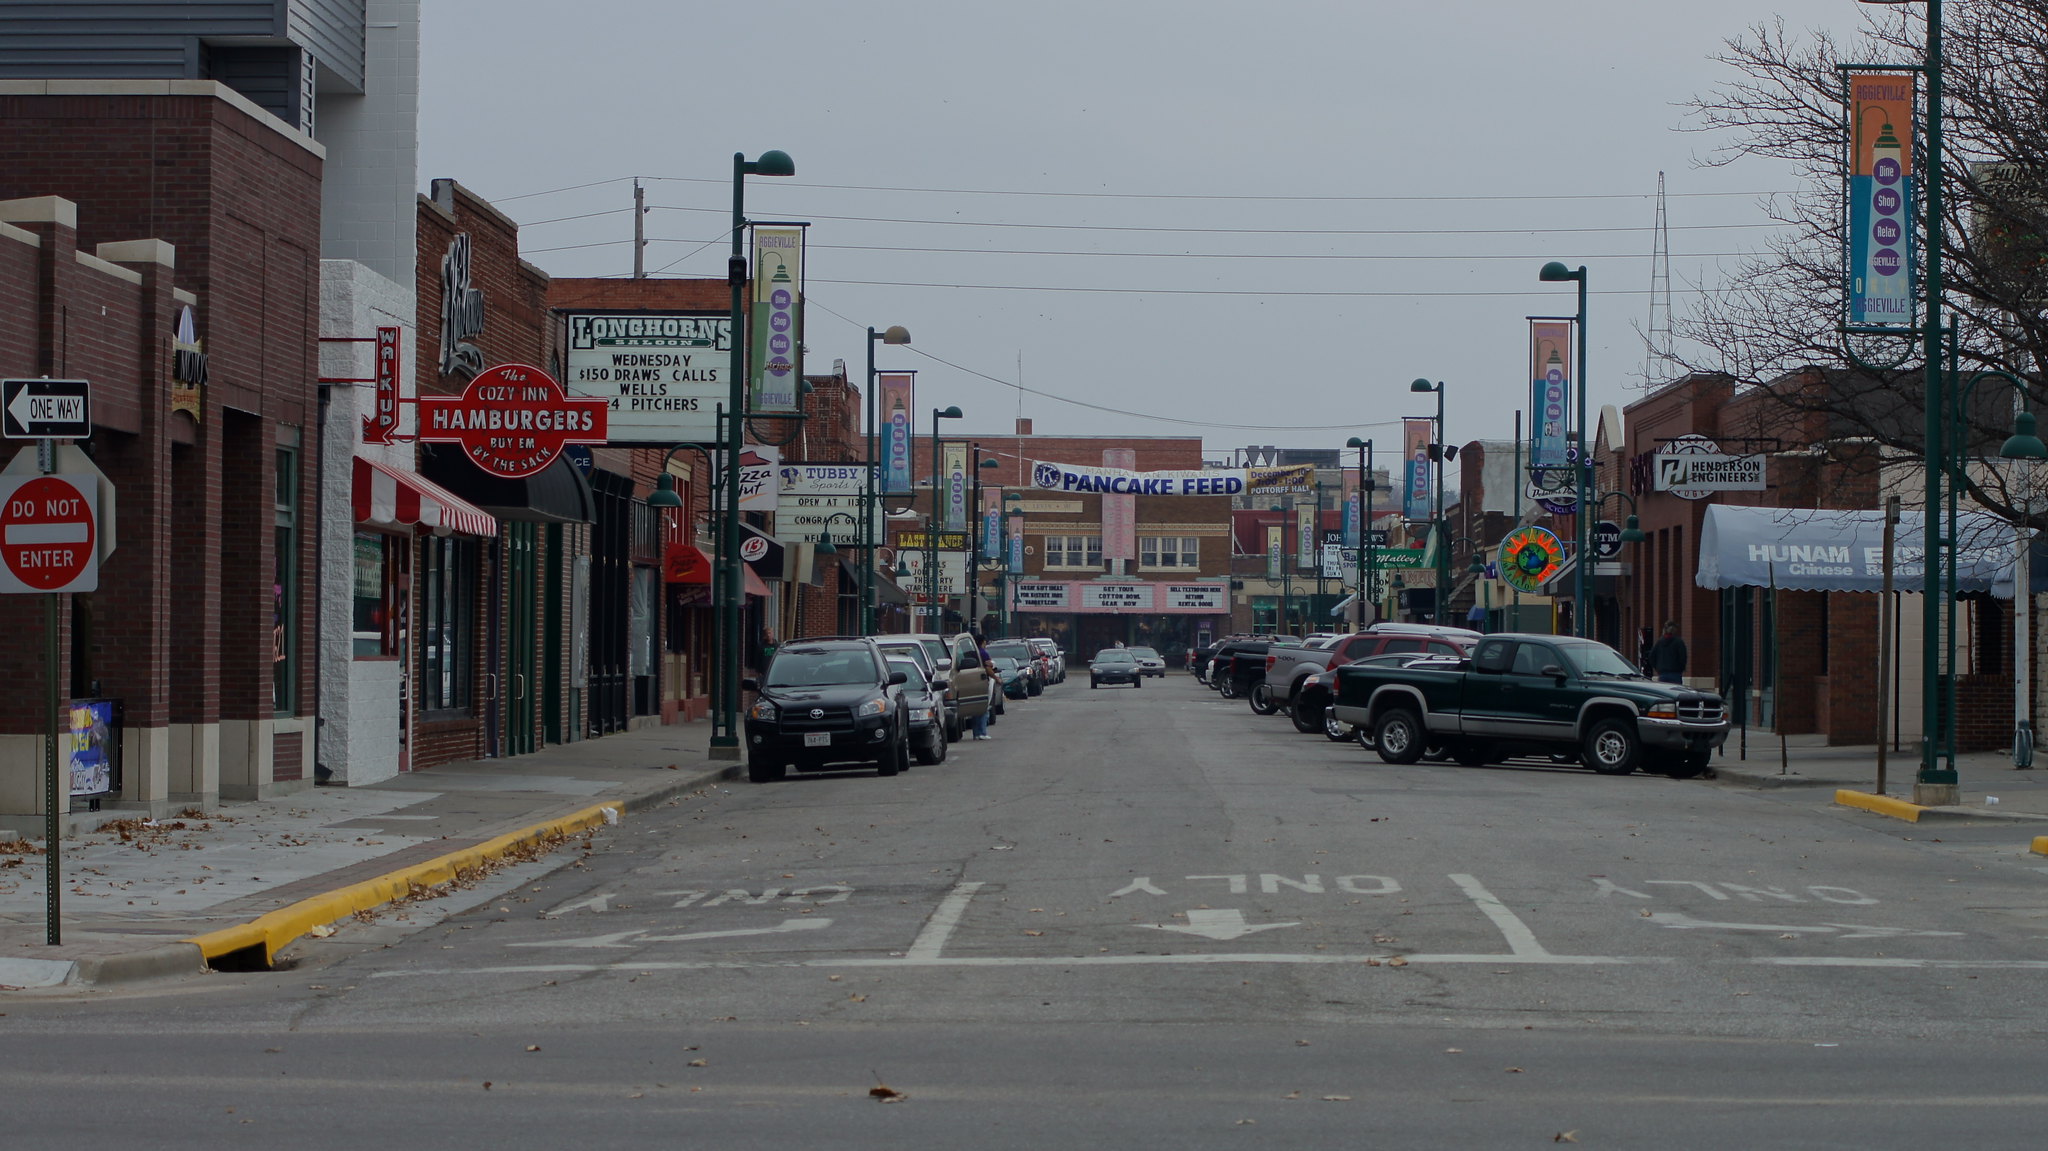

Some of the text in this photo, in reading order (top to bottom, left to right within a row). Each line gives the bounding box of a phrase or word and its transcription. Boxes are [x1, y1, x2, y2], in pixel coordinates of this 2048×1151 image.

[1856, 84, 1906, 100] AGGIEVILLE
[1879, 165, 1894, 177] Dine
[1878, 195, 1895, 209] Shop
[1877, 225, 1896, 237] Relax
[759, 236, 796, 249] AGGIEVILLE
[1855, 298, 1906, 313] AGGIEVILLE
[773, 316, 787, 328] Shop
[573, 317, 731, 350] LONGHORNS
[615, 338, 694, 346] SALOON
[772, 339, 787, 349] Relax
[379, 330, 396, 391] WALK
[612, 354, 692, 367] WEDNESDAY
[501, 369, 527, 382] The
[579, 368, 717, 381] $150 DRAWS CALLS
[478, 386, 549, 402] COZY INN
[620, 383, 667, 396] WELLS
[30, 398, 80, 419] ONE WAY
[631, 398, 698, 411] PITCHERS
[379, 399, 394, 427] UP
[433, 409, 593, 432] HAMBURGERS
[490, 437, 535, 449] BUY EM
[472, 445, 552, 472] BY THE SACK
[1692, 461, 1760, 472] HENDERSON
[806, 468, 880, 480] TUBBY'S
[1251, 468, 1294, 479] December
[1692, 472, 1753, 483] ENGINEERS
[810, 480, 849, 491] Sports
[1064, 472, 1243, 496] PANCAKE FEED
[1250, 486, 1289, 495] POTTORFF
[12, 499, 79, 518] DO NOT
[799, 499, 820, 507] OPEN
[827, 499, 838, 507] AT
[900, 533, 926, 548] LAST
[1599, 533, 1618, 542] TM
[20, 550, 74, 568] ENTER
[1748, 545, 1850, 563] HUNAM
[1788, 563, 1854, 576] Chinese
[1107, 873, 1403, 897] ONLY
